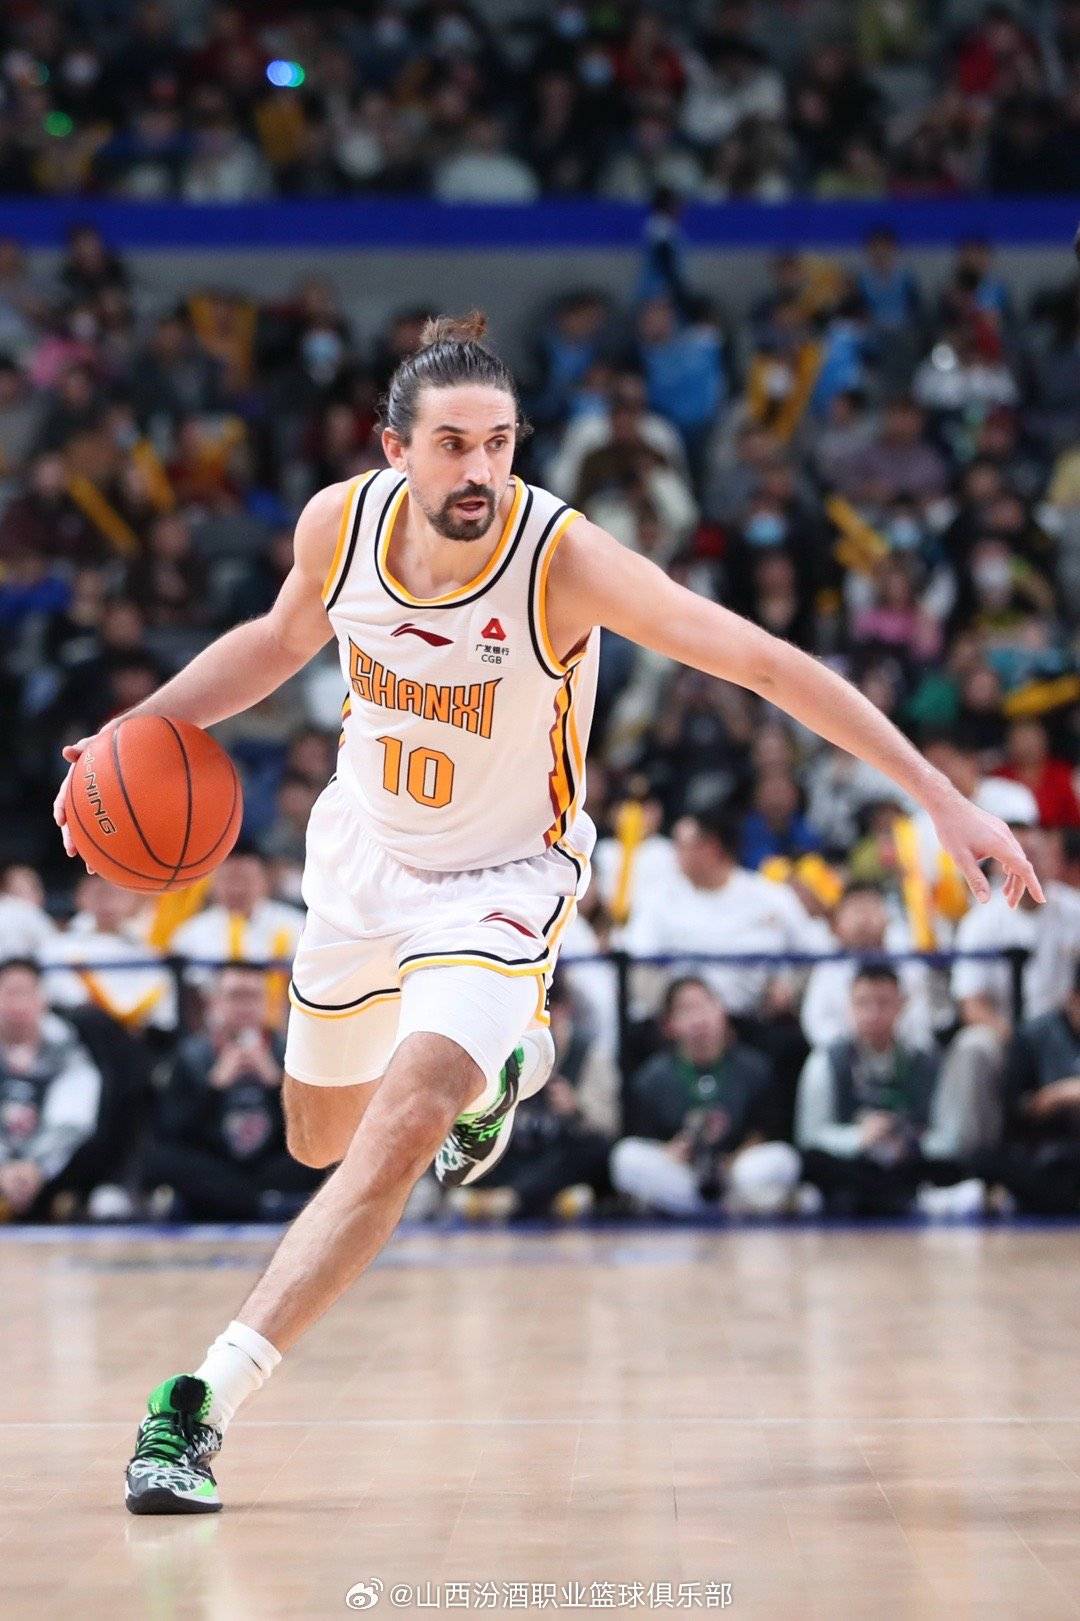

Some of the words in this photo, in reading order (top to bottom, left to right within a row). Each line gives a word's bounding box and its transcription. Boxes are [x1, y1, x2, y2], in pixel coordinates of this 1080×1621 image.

[475, 643, 510, 656] 广发银行
[481, 653, 502, 665] CGB
[348, 635, 503, 739] SHANXI
[375, 735, 455, 808] 10
